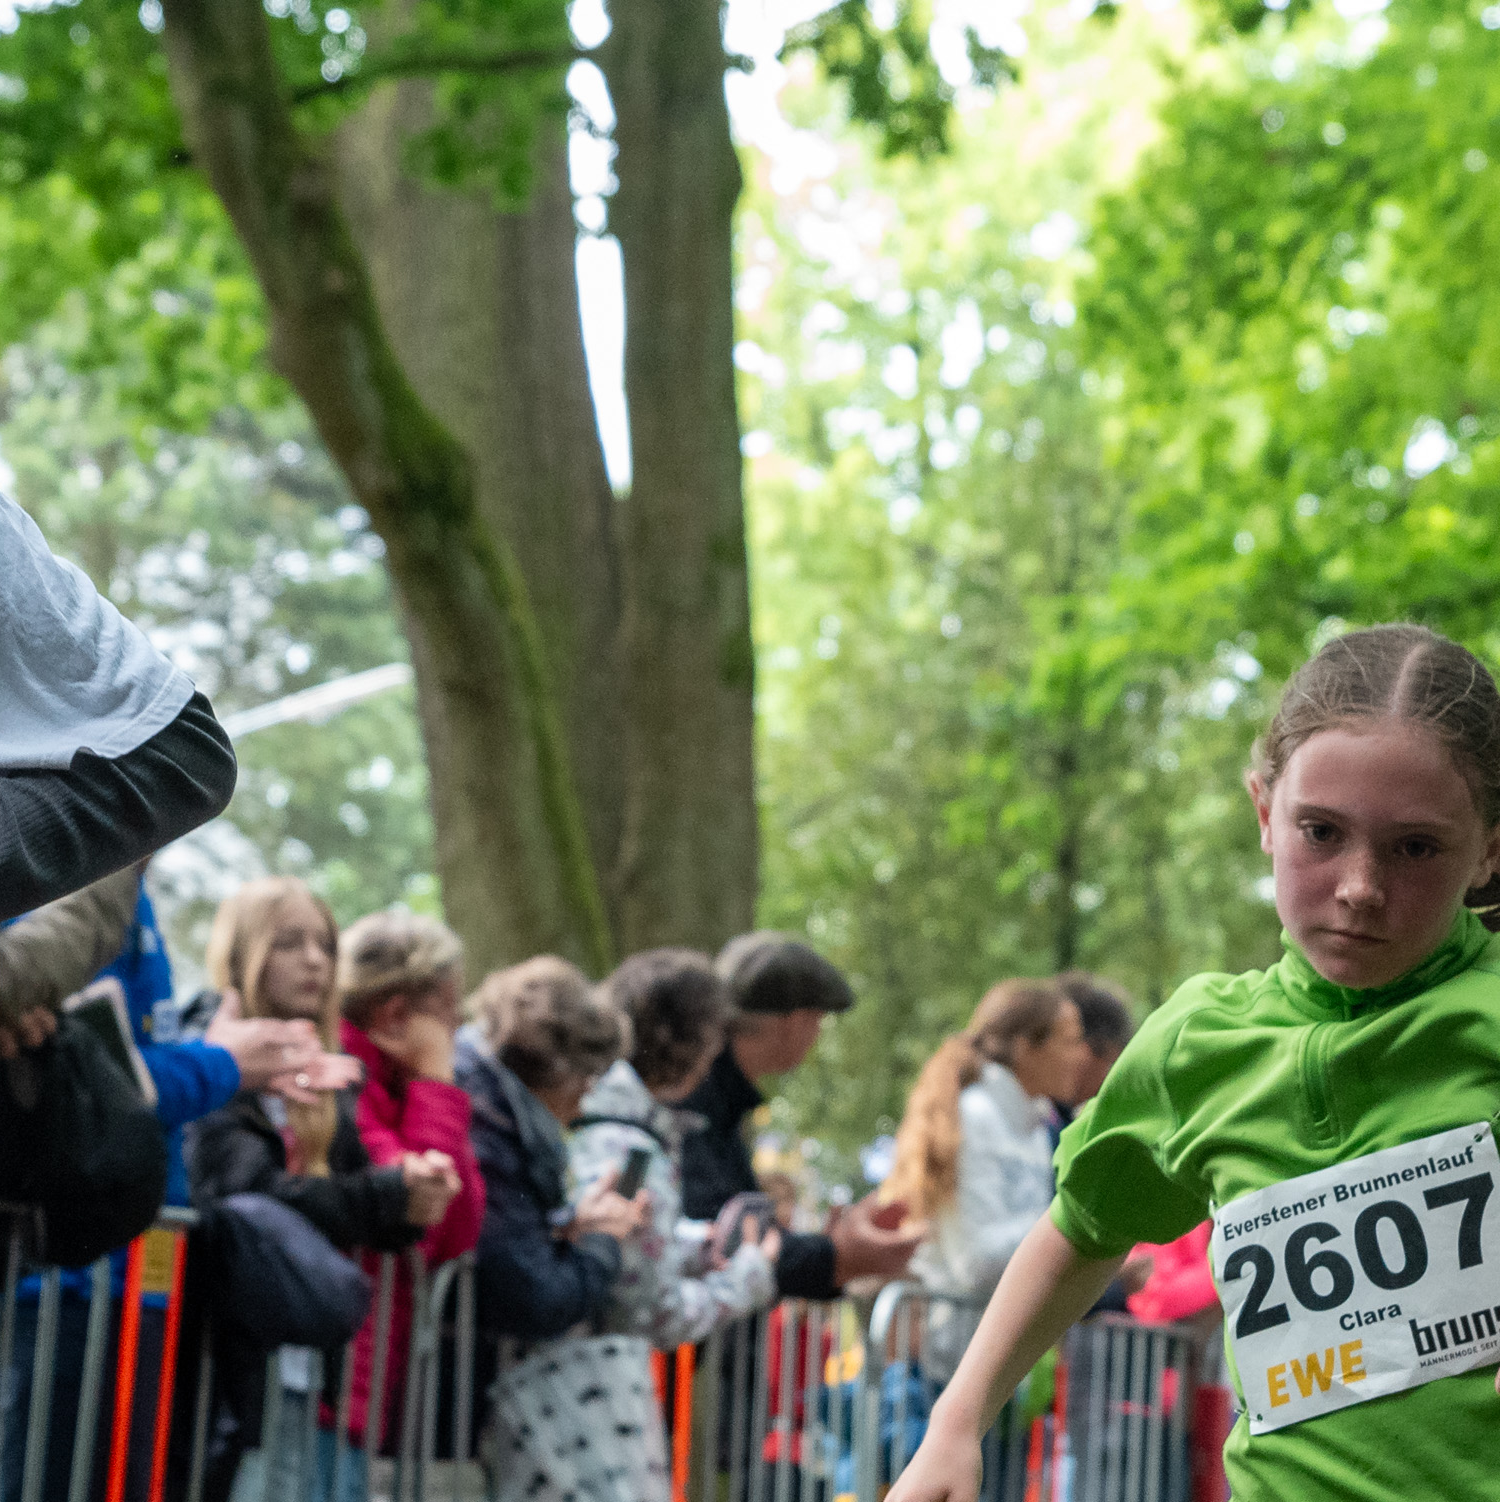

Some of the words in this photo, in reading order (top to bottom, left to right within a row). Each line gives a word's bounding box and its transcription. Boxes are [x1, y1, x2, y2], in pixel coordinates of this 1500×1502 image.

[1223, 1192, 1328, 1242] Everstener
[1333, 1145, 1475, 1203] Brunnenlauf
[1223, 1171, 1495, 1340] 2607
[1339, 1303, 1403, 1332] Clara
[1481, 1340, 1498, 1351] SEIT
[1266, 1339, 1367, 1409] EWE
